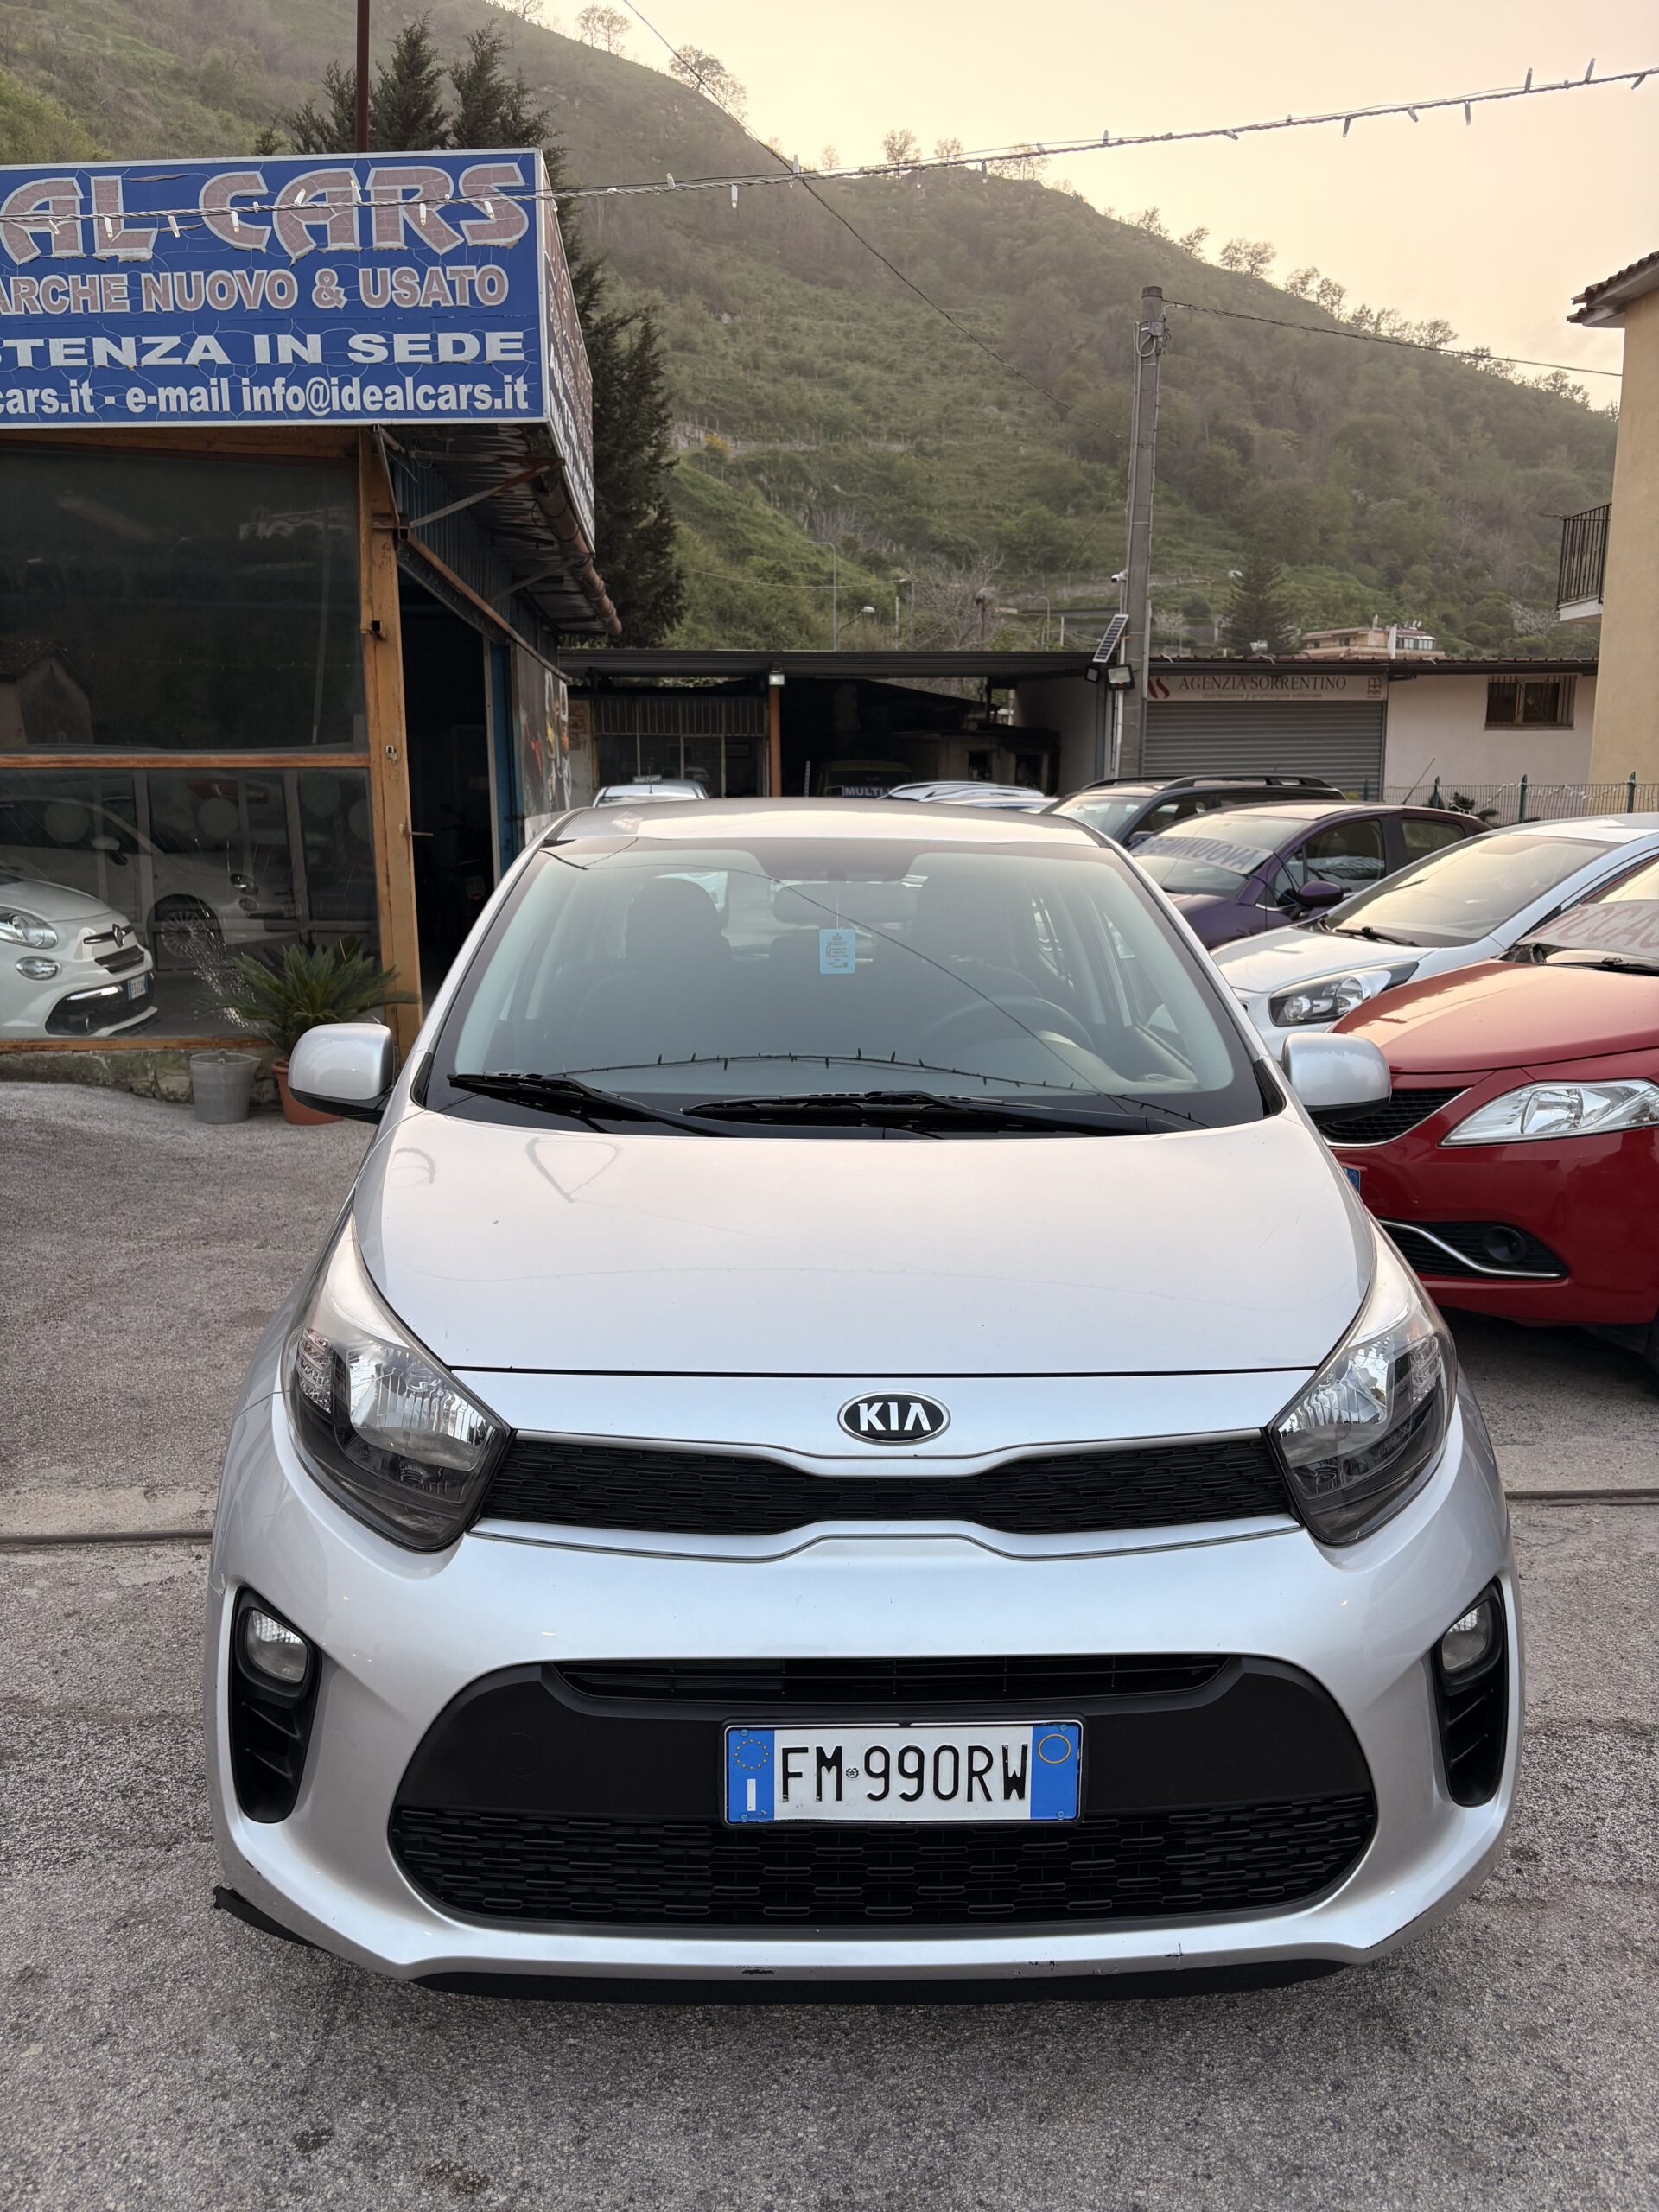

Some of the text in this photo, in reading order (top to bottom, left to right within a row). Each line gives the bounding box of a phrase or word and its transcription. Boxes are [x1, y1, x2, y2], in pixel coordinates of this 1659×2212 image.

[0, 162, 530, 264] AL CARS
[141, 269, 299, 313] NUOVO
[312, 268, 348, 310] &
[359, 264, 510, 309] USATO
[0, 331, 525, 369] TENZA IN SEDE
[126, 378, 231, 414] e-mail
[242, 374, 529, 416] info@idealcars.it
[1178, 677, 1245, 691] AGENZIA
[1249, 676, 1347, 691] SORRENTINO
[858, 1402, 931, 1432] KIA
[747, 1778, 757, 1812] I
